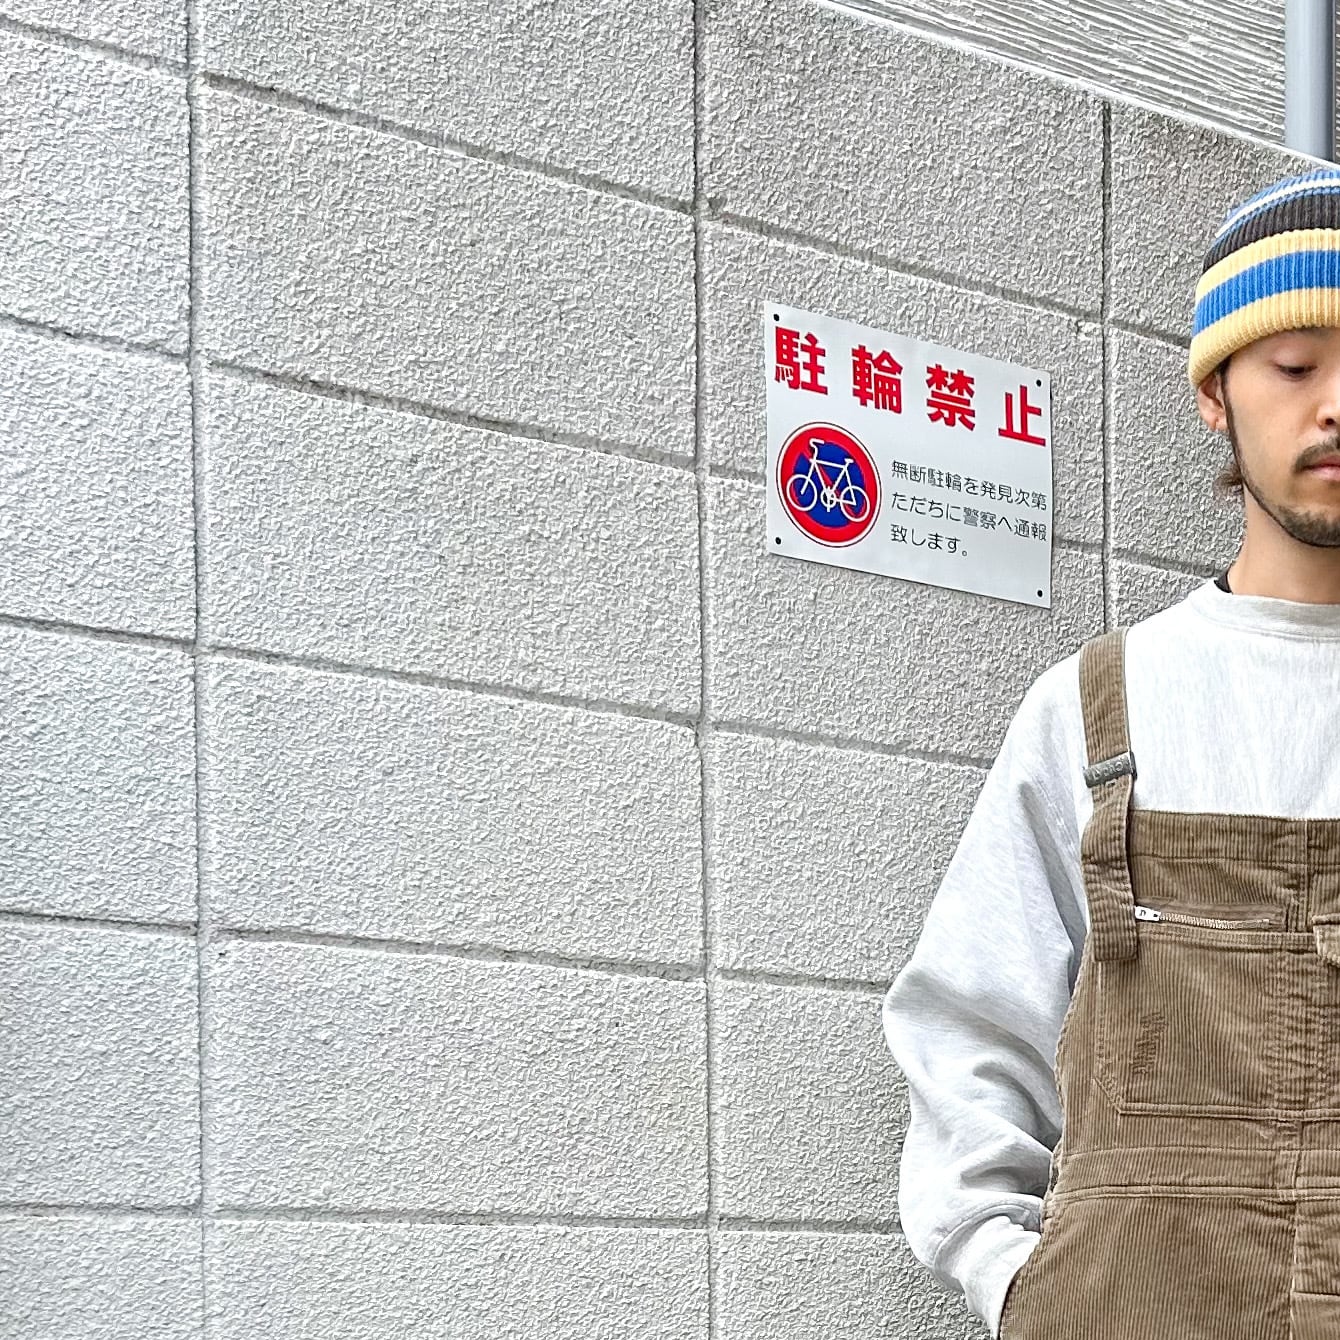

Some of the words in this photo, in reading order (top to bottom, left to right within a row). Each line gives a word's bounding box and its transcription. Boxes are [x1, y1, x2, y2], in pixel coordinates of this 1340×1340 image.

[775, 326, 1047, 447] 駐輪禁止
[891, 460, 1047, 511] 無断駐輪を発見次第
[890, 523, 968, 557] 致します。
[891, 491, 1047, 542] ただちに警察へ通報
